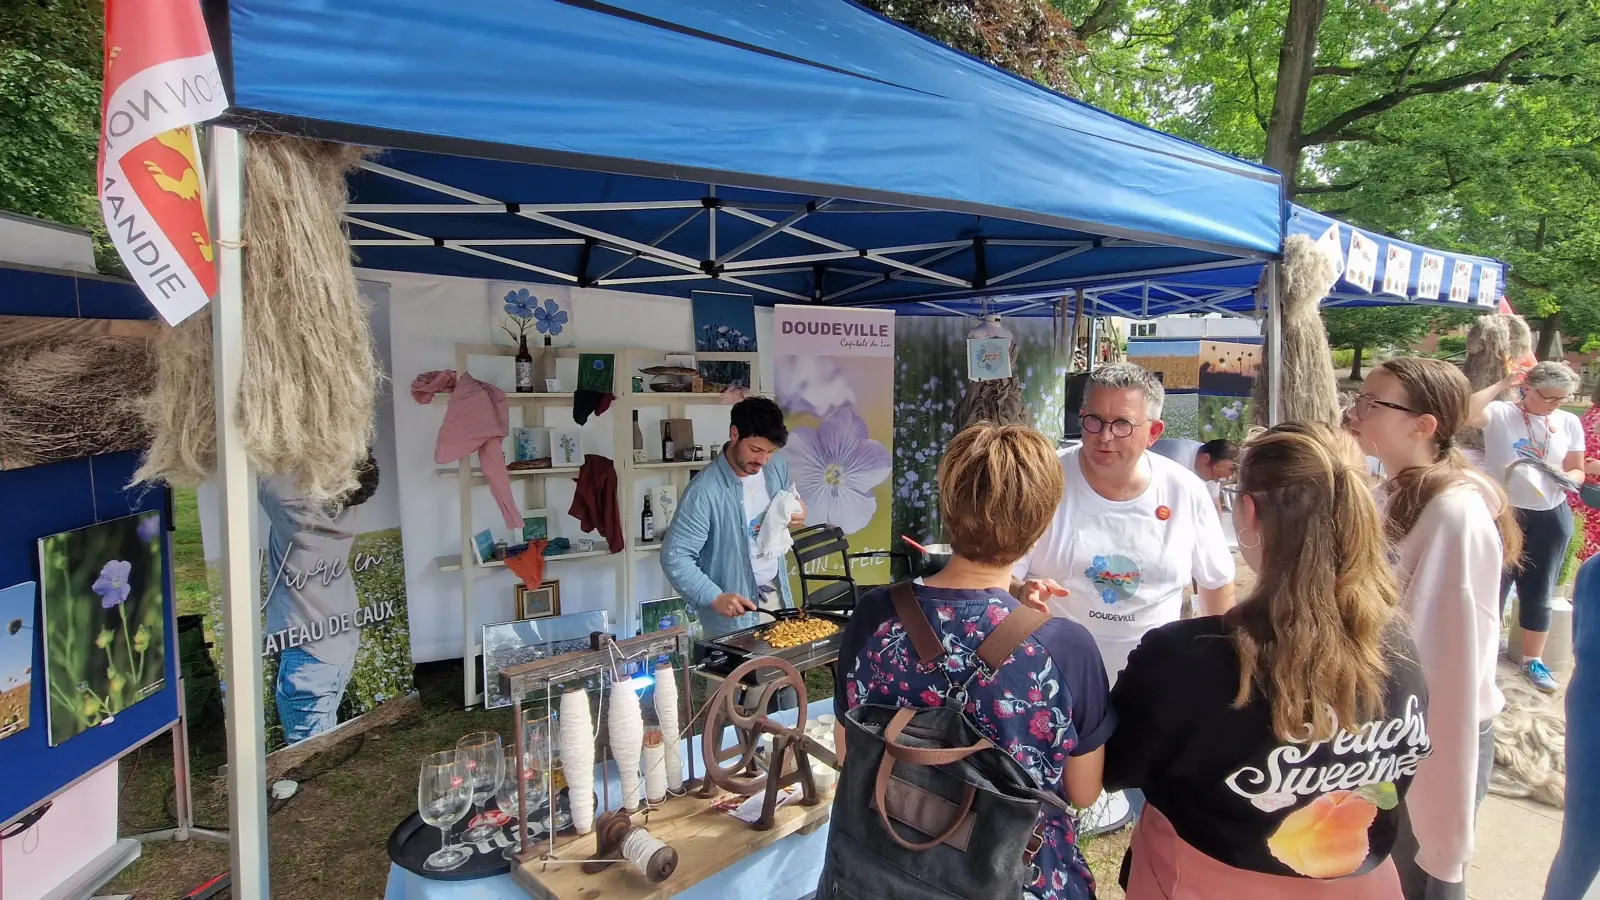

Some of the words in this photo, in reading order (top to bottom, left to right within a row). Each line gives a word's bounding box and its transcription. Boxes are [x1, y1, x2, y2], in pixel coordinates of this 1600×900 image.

[781, 320, 889, 337] DOUDEVILLE
[839, 337, 868, 349] Capitale
[869, 339, 879, 347] du
[353, 551, 383, 573] en
[328, 612, 350, 636] DE
[353, 599, 396, 628] CAUX
[1088, 610, 1136, 622] DOUDEVILLE
